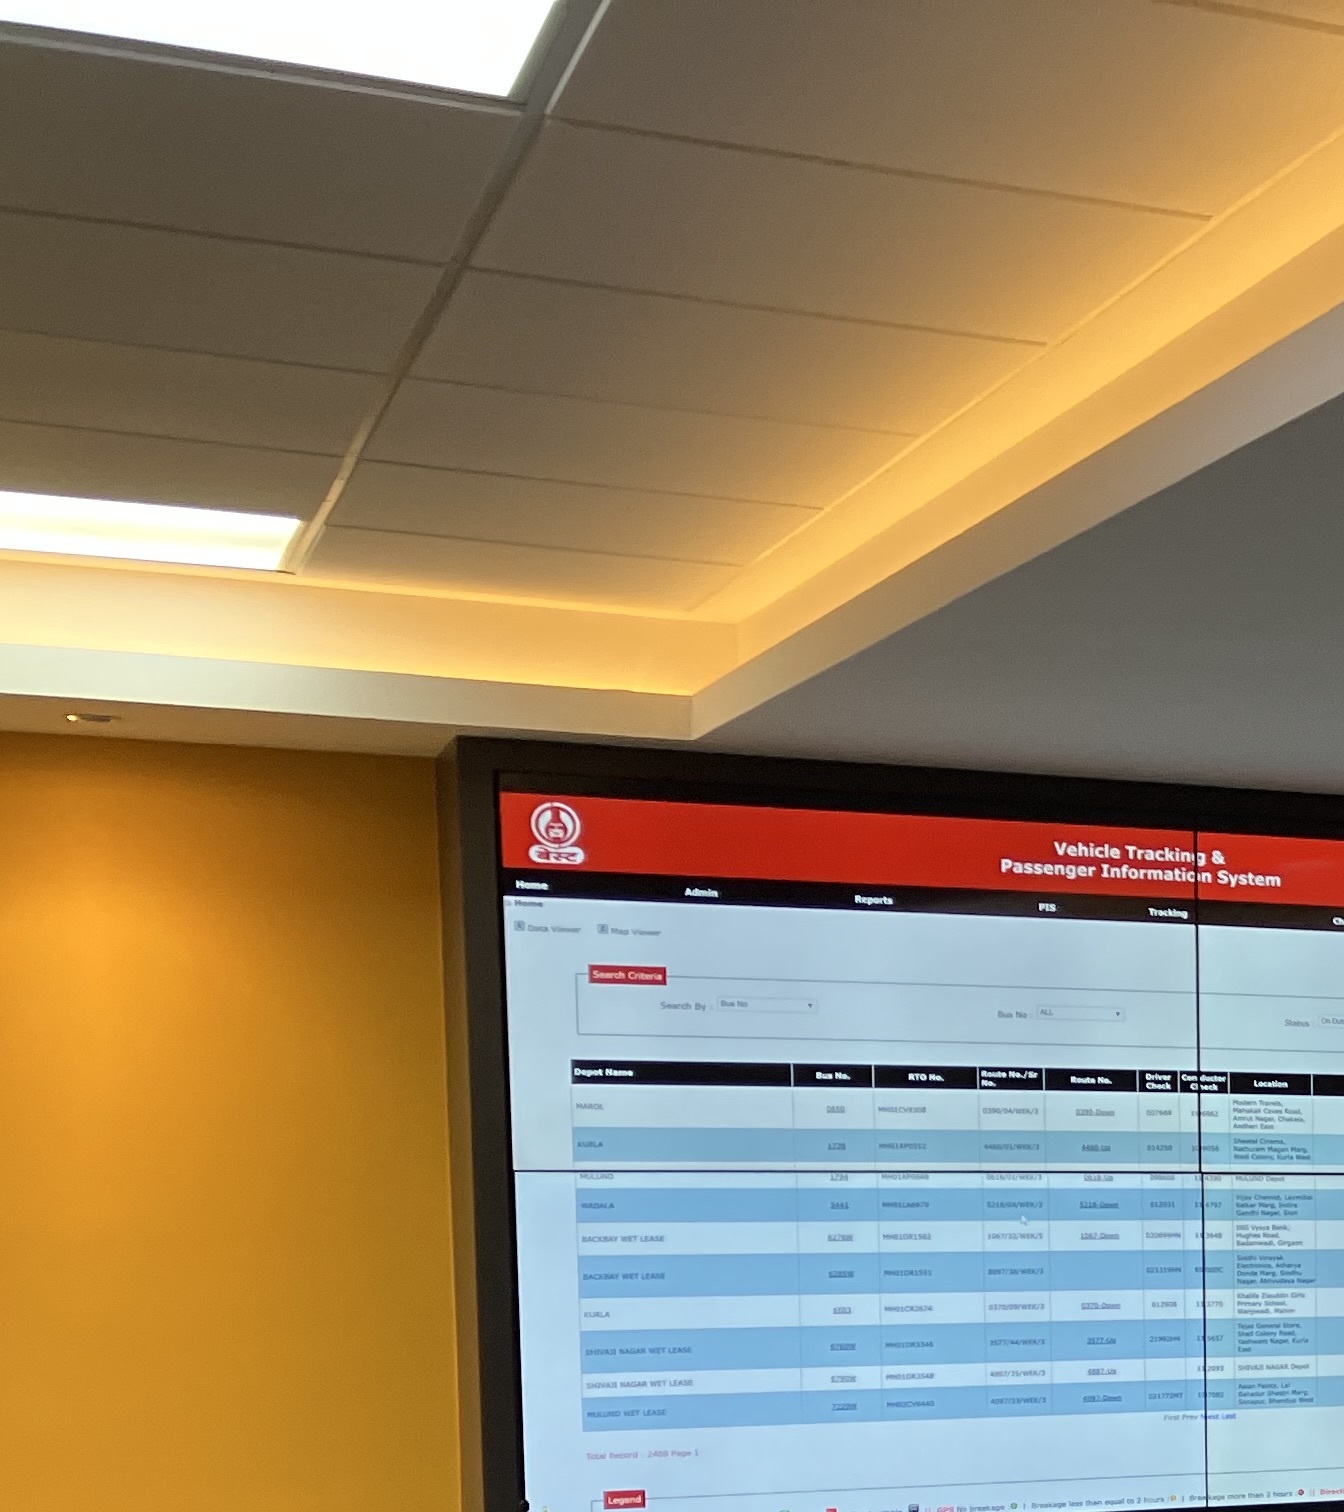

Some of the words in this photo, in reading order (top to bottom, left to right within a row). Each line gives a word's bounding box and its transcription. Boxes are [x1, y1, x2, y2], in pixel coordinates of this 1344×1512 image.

[1053, 841, 1121, 860] Vehicle
[1124, 844, 1206, 866] Tracking
[1211, 850, 1226, 865] &
[1001, 858, 1096, 880] Passenger
[1100, 863, 1212, 884] Information
[1217, 869, 1282, 888] System
[515, 880, 549, 891] Home
[684, 887, 719, 899] Admin
[514, 900, 544, 909] Home
[854, 894, 894, 907] Reports
[1038, 903, 1057, 913] PIS
[1148, 908, 1189, 920] Tracking
[592, 970, 625, 980] Search
[628, 971, 663, 982] Criteria
[720, 1000, 735, 1008] Bus
[736, 1000, 748, 1008] No
[997, 1010, 1014, 1019] Bus
[1015, 1010, 1028, 1019] No
[1040, 1008, 1054, 1016] ALL
[1284, 1018, 1310, 1028] Status
[574, 1068, 604, 1079] Depot
[605, 1068, 634, 1078] Name
[816, 1072, 833, 1080] Bus
[834, 1072, 852, 1080] No.
[908, 1072, 928, 1082] RTO
[929, 1073, 945, 1082] No.
[980, 1070, 1007, 1079] Route
[1008, 1070, 1038, 1080] No./Sr
[1145, 1073, 1172, 1082] Driver
[980, 1079, 997, 1088] No.
[1070, 1076, 1097, 1085] Route
[1098, 1076, 1113, 1085] No.
[1253, 1080, 1289, 1089] Location
[1146, 1082, 1172, 1091] Check
[582, 1235, 618, 1243] BACKBAY
[620, 1235, 639, 1243] WET
[640, 1234, 664, 1242] LEASE
[583, 1272, 620, 1281] BACKBAY
[622, 1272, 640, 1280] WET
[642, 1272, 666, 1280] LEASE
[584, 1311, 611, 1319] KURLA
[585, 1348, 617, 1356] SHIVAJI
[668, 1346, 693, 1354] LEASE
[586, 1382, 618, 1390] SHIVAJI
[650, 1380, 667, 1388] WET
[608, 1494, 642, 1506] Legend
[1031, 1501, 1067, 1511] Breakage
[1068, 1500, 1084, 1508] less
[1086, 1498, 1103, 1507] than
[1104, 1498, 1125, 1508] equal
[1144, 1496, 1165, 1505] hours
